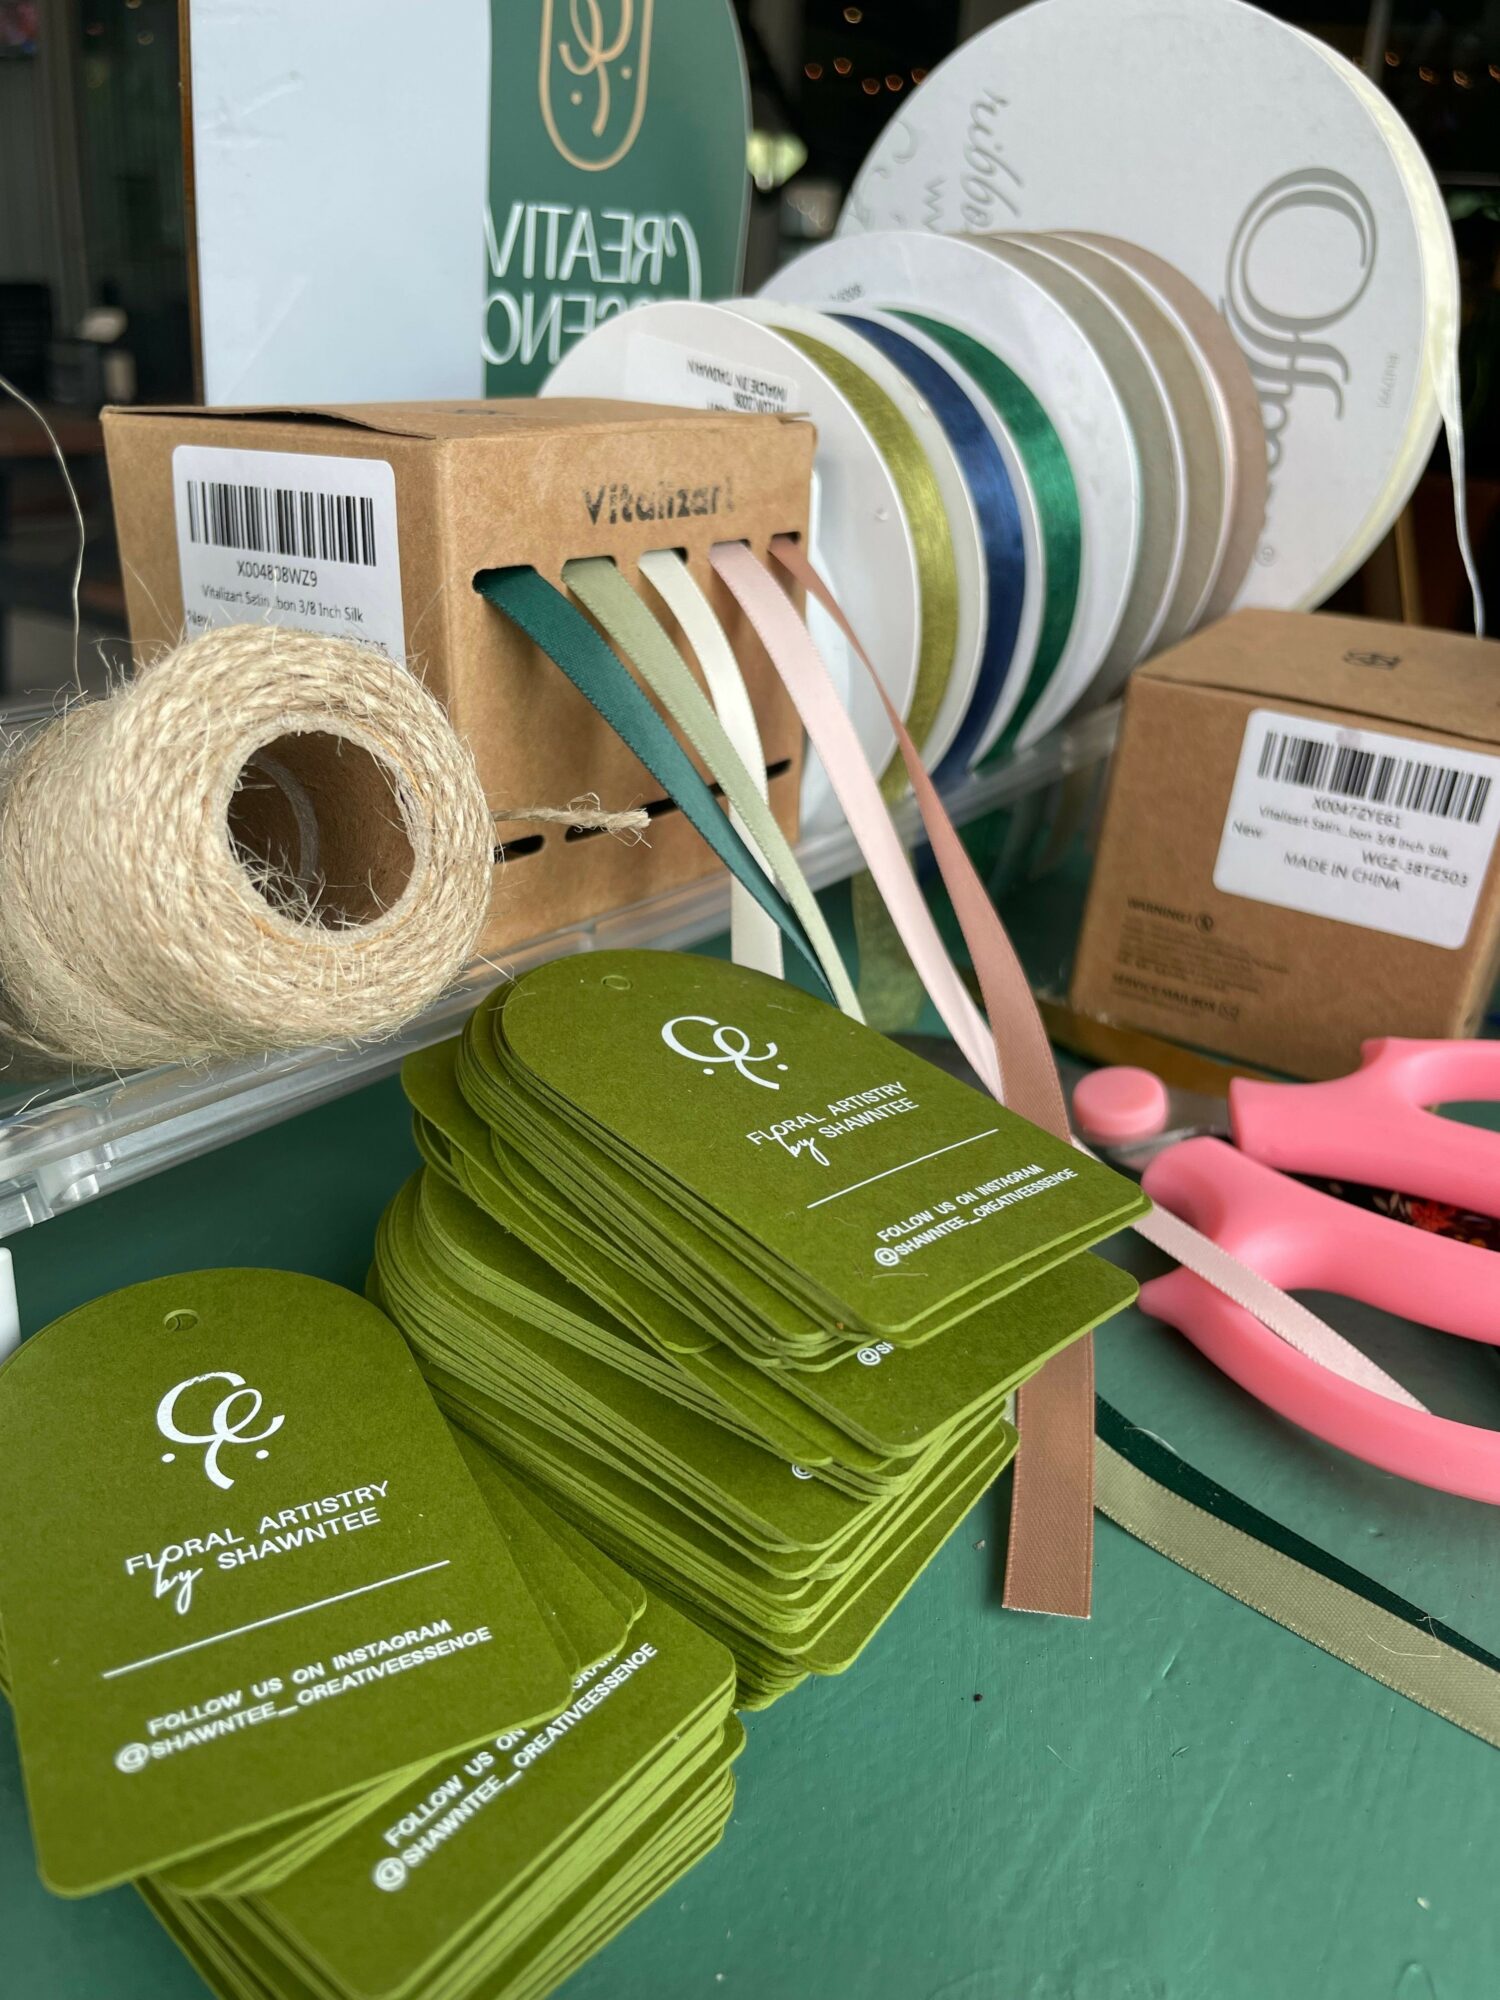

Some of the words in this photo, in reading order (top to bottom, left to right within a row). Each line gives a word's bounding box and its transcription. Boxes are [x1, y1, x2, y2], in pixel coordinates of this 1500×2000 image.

[959, 89, 1024, 233] ribbo
[344, 606, 365, 624] Silk
[1231, 819, 1265, 840] New
[1282, 850, 1328, 876] MADE
[1330, 862, 1348, 879] IN
[1351, 867, 1402, 893] CHINA
[746, 1111, 827, 1146] FLORAL
[826, 1080, 908, 1117] ARTISTRY
[773, 1133, 831, 1167] by
[817, 1096, 920, 1139] SHAWNTEE
[876, 1209, 936, 1243] FOLLOW
[932, 1200, 958, 1215] US
[955, 1190, 980, 1206] ON
[974, 1162, 1046, 1197] INSTAGRAM
[124, 1527, 245, 1576] FLORAL
[257, 1479, 389, 1535] ARTISTRY
[154, 1556, 204, 1616] by
[216, 1506, 382, 1570] SHAWNTEE
[146, 1688, 243, 1737] FOLLOW
[251, 1676, 284, 1699] US
[291, 1661, 326, 1685] ON
[330, 1618, 453, 1671] INSTAGRAM
[382, 1773, 464, 1849] FOLLOW
[462, 1750, 495, 1777] US
